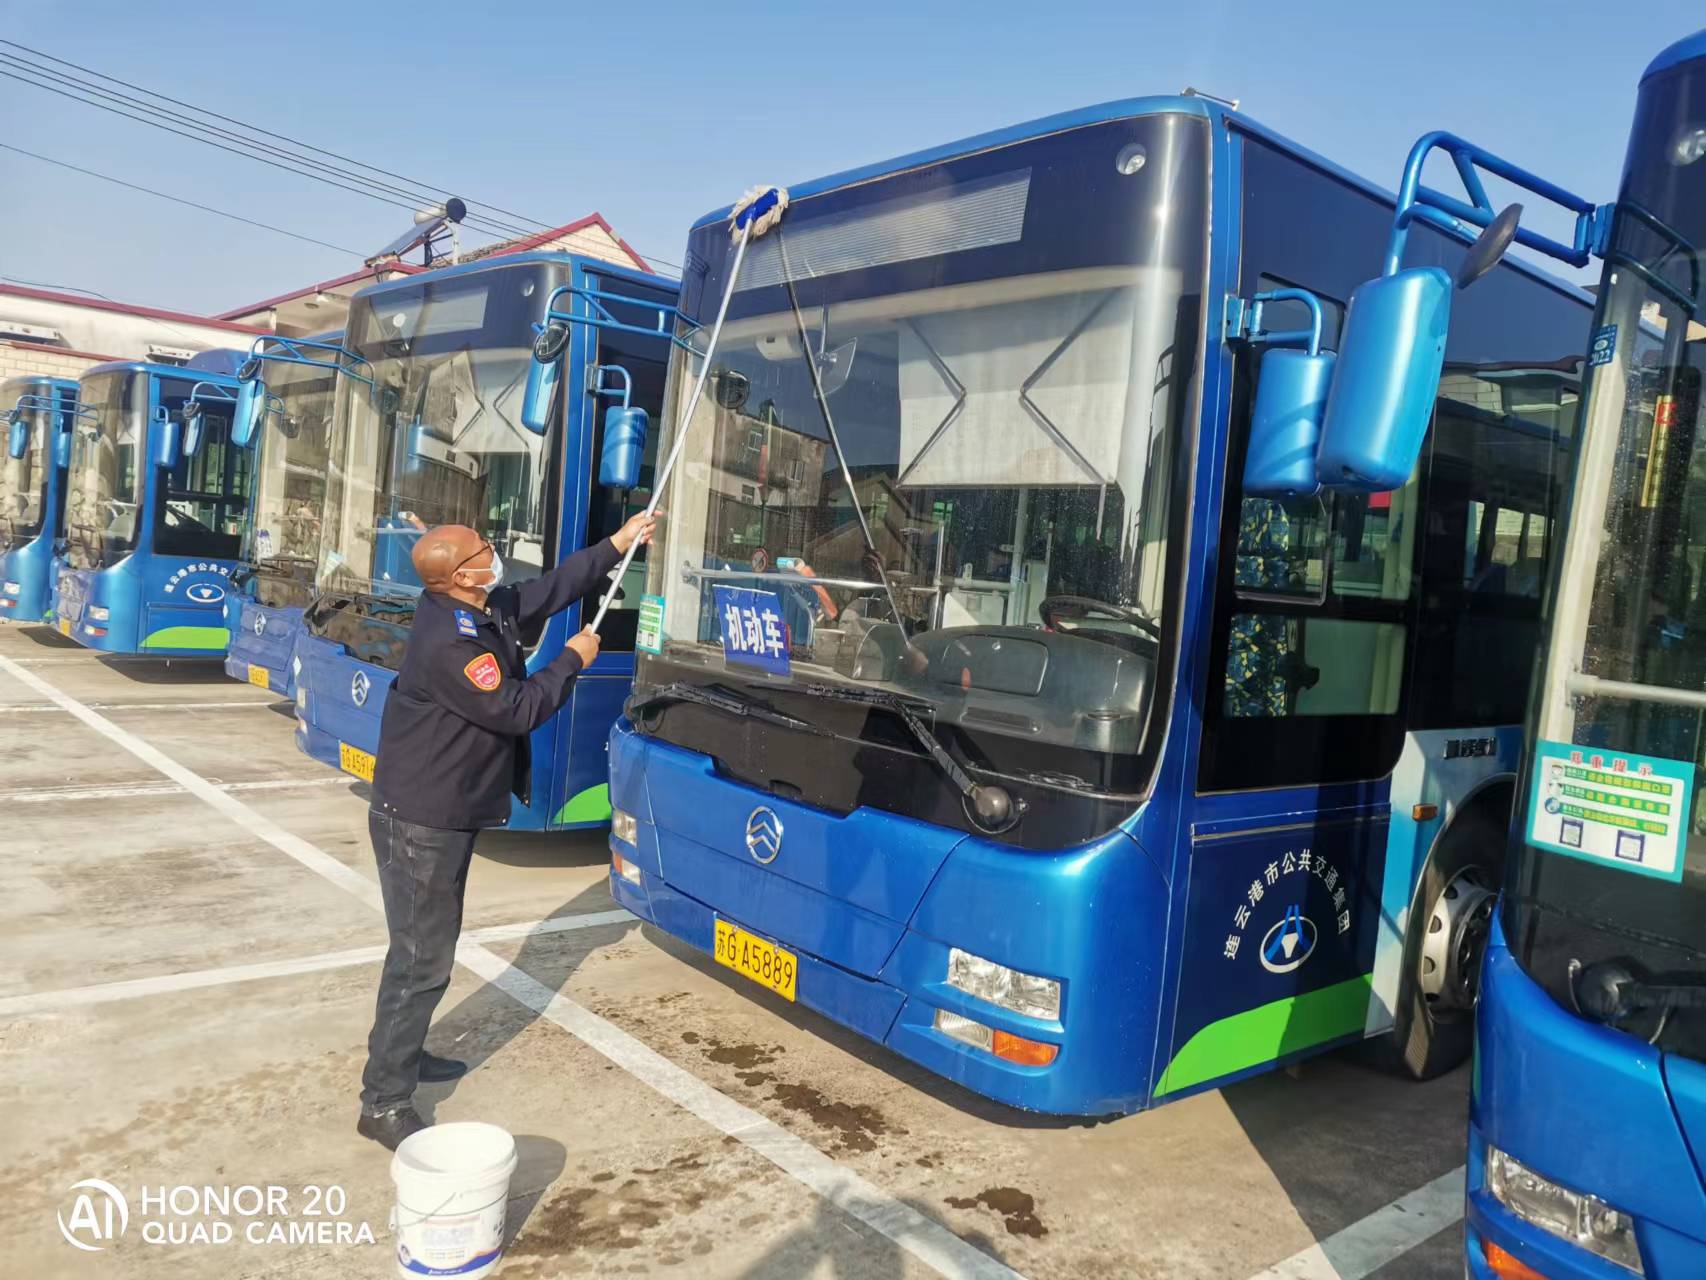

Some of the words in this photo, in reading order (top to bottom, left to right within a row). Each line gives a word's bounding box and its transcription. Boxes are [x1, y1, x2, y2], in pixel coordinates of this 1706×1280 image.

[725, 603, 784, 658] 机动车
[1224, 848, 1350, 961] 连云港市公共交通集团
